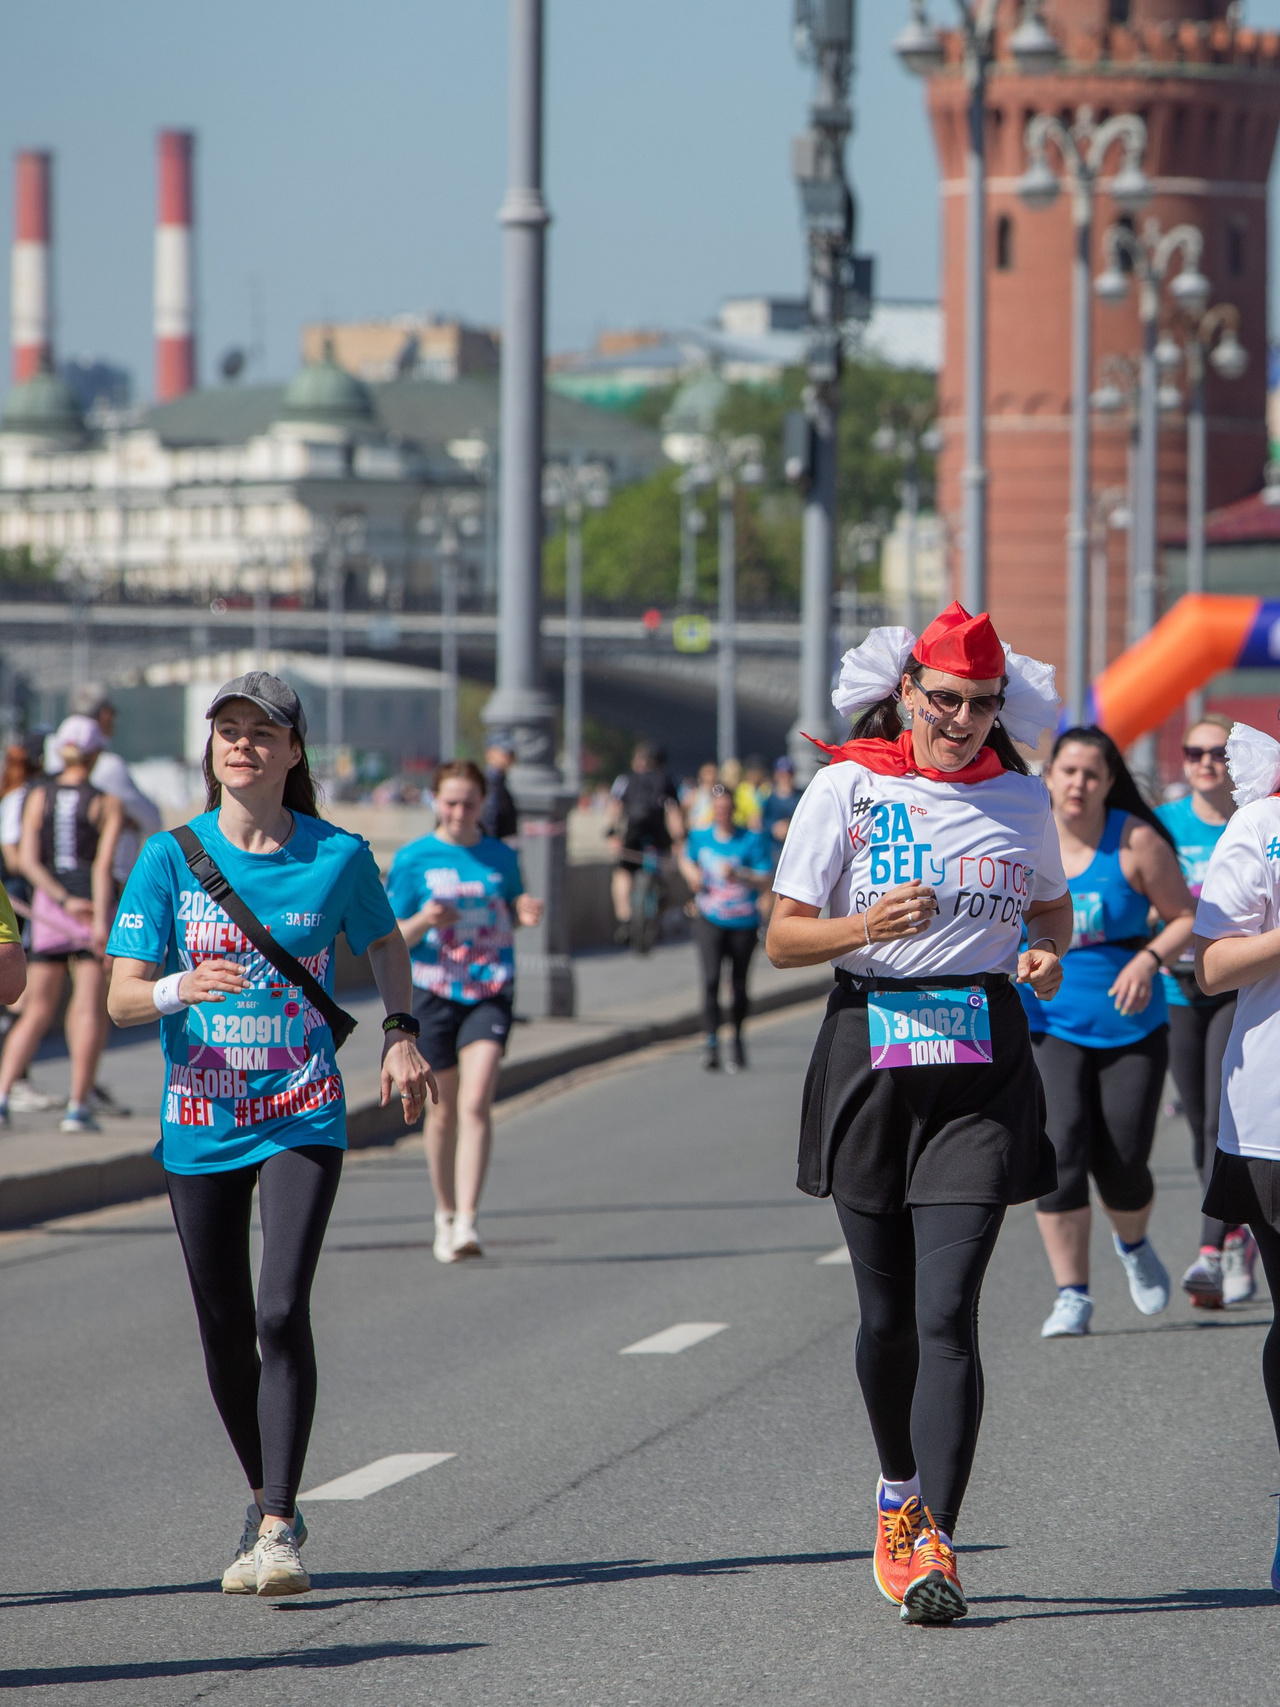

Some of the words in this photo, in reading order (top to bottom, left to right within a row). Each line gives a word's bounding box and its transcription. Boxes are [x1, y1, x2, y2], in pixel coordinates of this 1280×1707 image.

[118, 912, 144, 929] ПСБ
[211, 1014, 282, 1044] 32091
[893, 1007, 967, 1039] 31062
